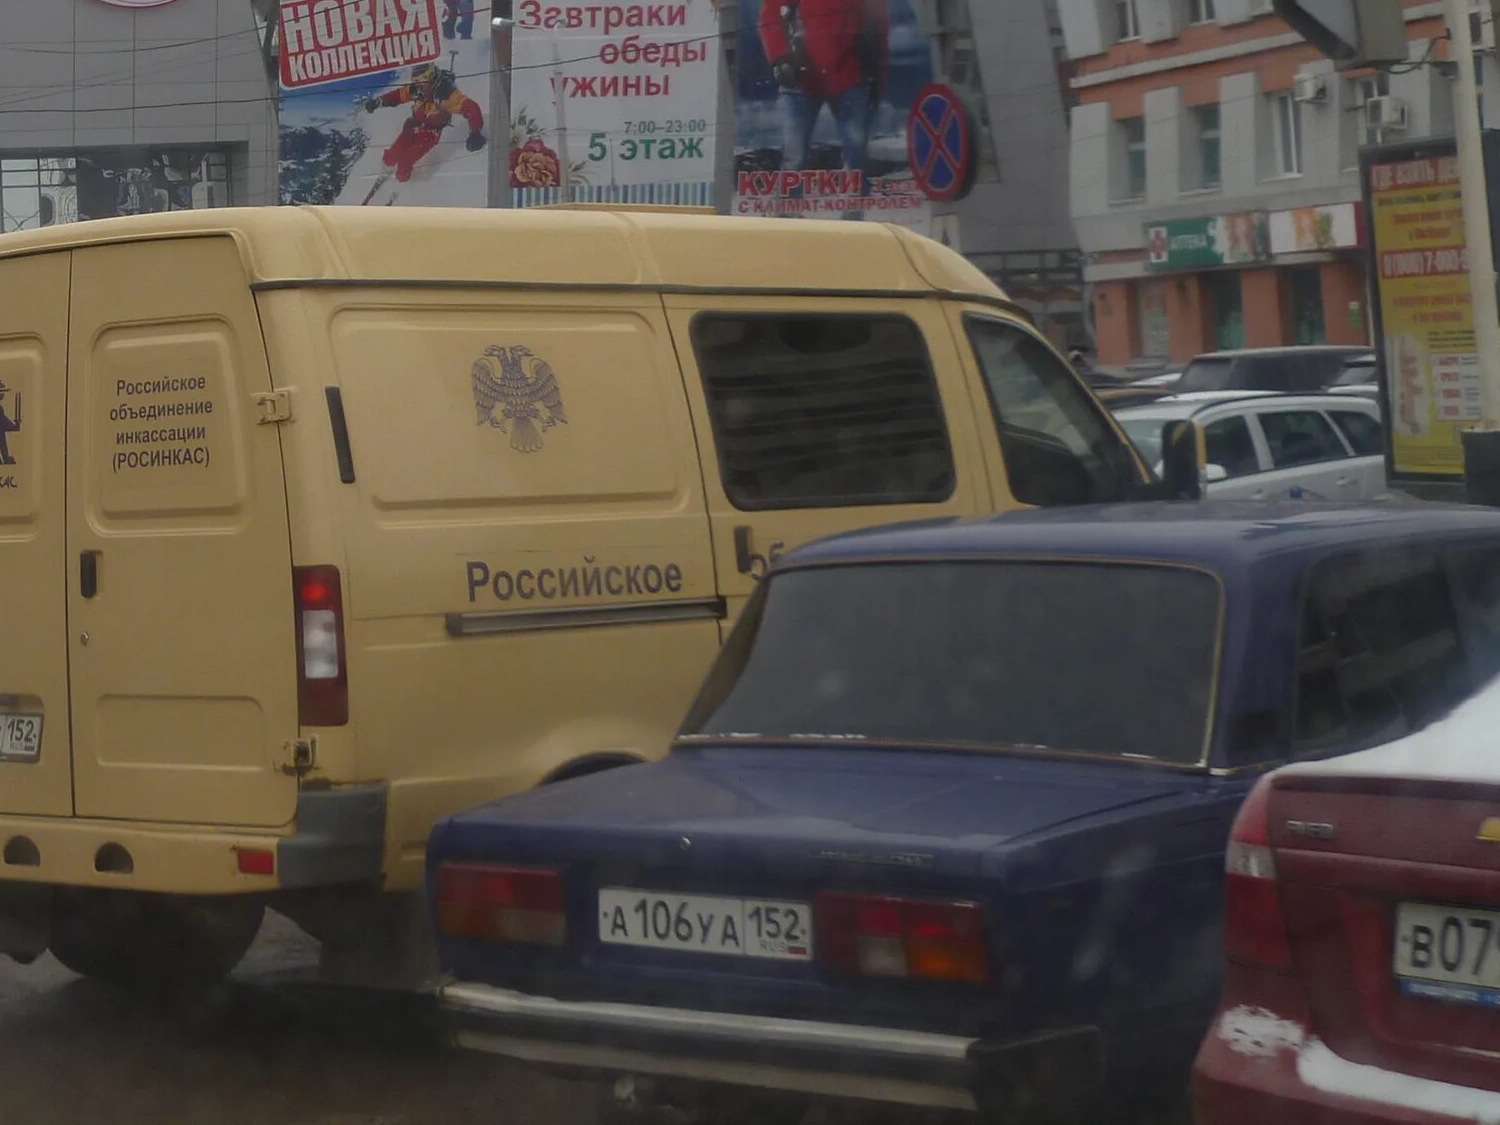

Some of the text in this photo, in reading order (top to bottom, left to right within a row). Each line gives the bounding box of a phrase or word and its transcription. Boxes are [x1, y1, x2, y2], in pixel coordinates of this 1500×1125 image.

[519, 0, 686, 34] Завтраки
[288, 28, 436, 82] КОЛЛЕКЦИЯ
[600, 35, 706, 66] обеды
[550, 74, 671, 105] ужины
[587, 132, 704, 163] 5 этаж
[738, 169, 862, 197] КУРТКИ
[116, 375, 207, 397] Российское
[109, 399, 213, 422] объединение
[116, 425, 206, 446] инкассации
[112, 446, 211, 474] (РОСИНКАС)
[466, 554, 683, 602] Российское
[7, 718, 34, 742] 152
[748, 905, 801, 942] 152
[1411, 916, 1500, 976] В07
